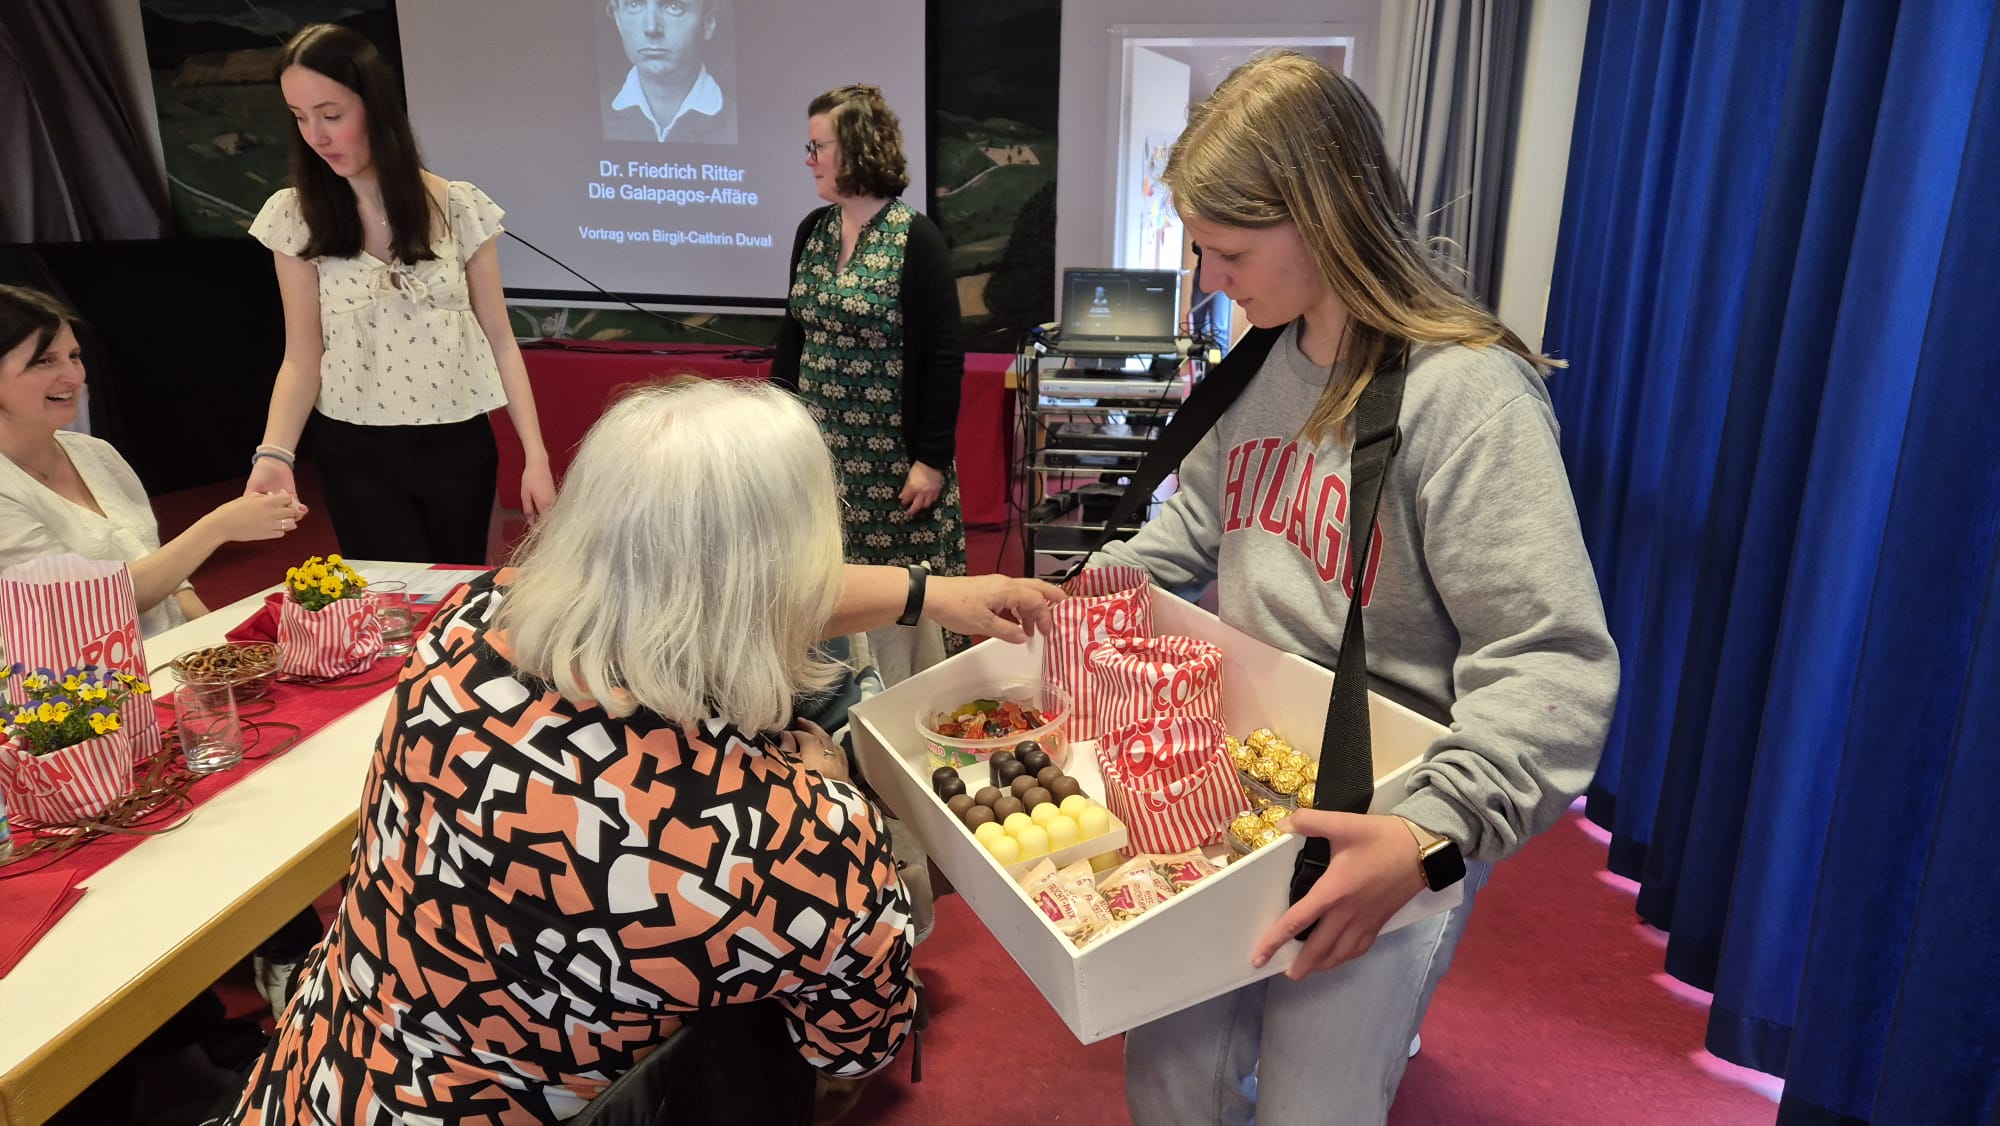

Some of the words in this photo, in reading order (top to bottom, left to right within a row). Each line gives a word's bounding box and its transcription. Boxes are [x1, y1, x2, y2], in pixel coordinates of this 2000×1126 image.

[600, 160, 623, 177] Dr.
[628, 162, 697, 180] Friedrich
[701, 164, 745, 181] Ritter
[589, 183, 615, 199] Die
[620, 184, 758, 206] Galapagos-Affäre
[578, 226, 624, 243] Vortrag
[627, 230, 649, 241] von
[652, 229, 733, 246] Birgit-Cathrin
[736, 233, 772, 247] Duval
[1153, 656, 1218, 712] CORN
